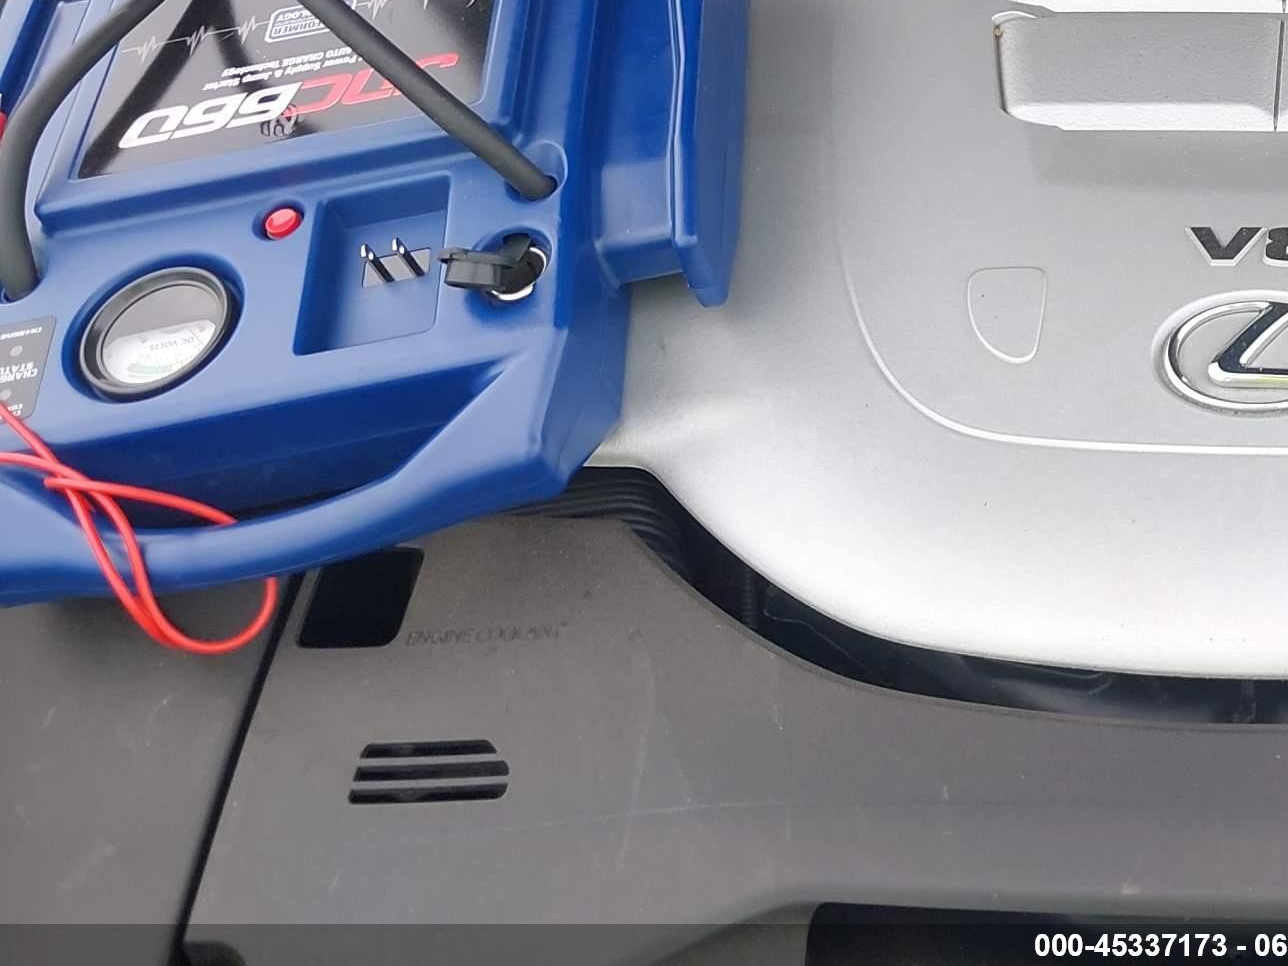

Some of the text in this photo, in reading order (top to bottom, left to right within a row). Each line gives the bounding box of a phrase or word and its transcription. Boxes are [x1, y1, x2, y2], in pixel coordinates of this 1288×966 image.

[280, 51, 324, 66] CHARGE
[202, 54, 356, 91] Power Supply & Jump Starter
[220, 60, 280, 77] Technology
